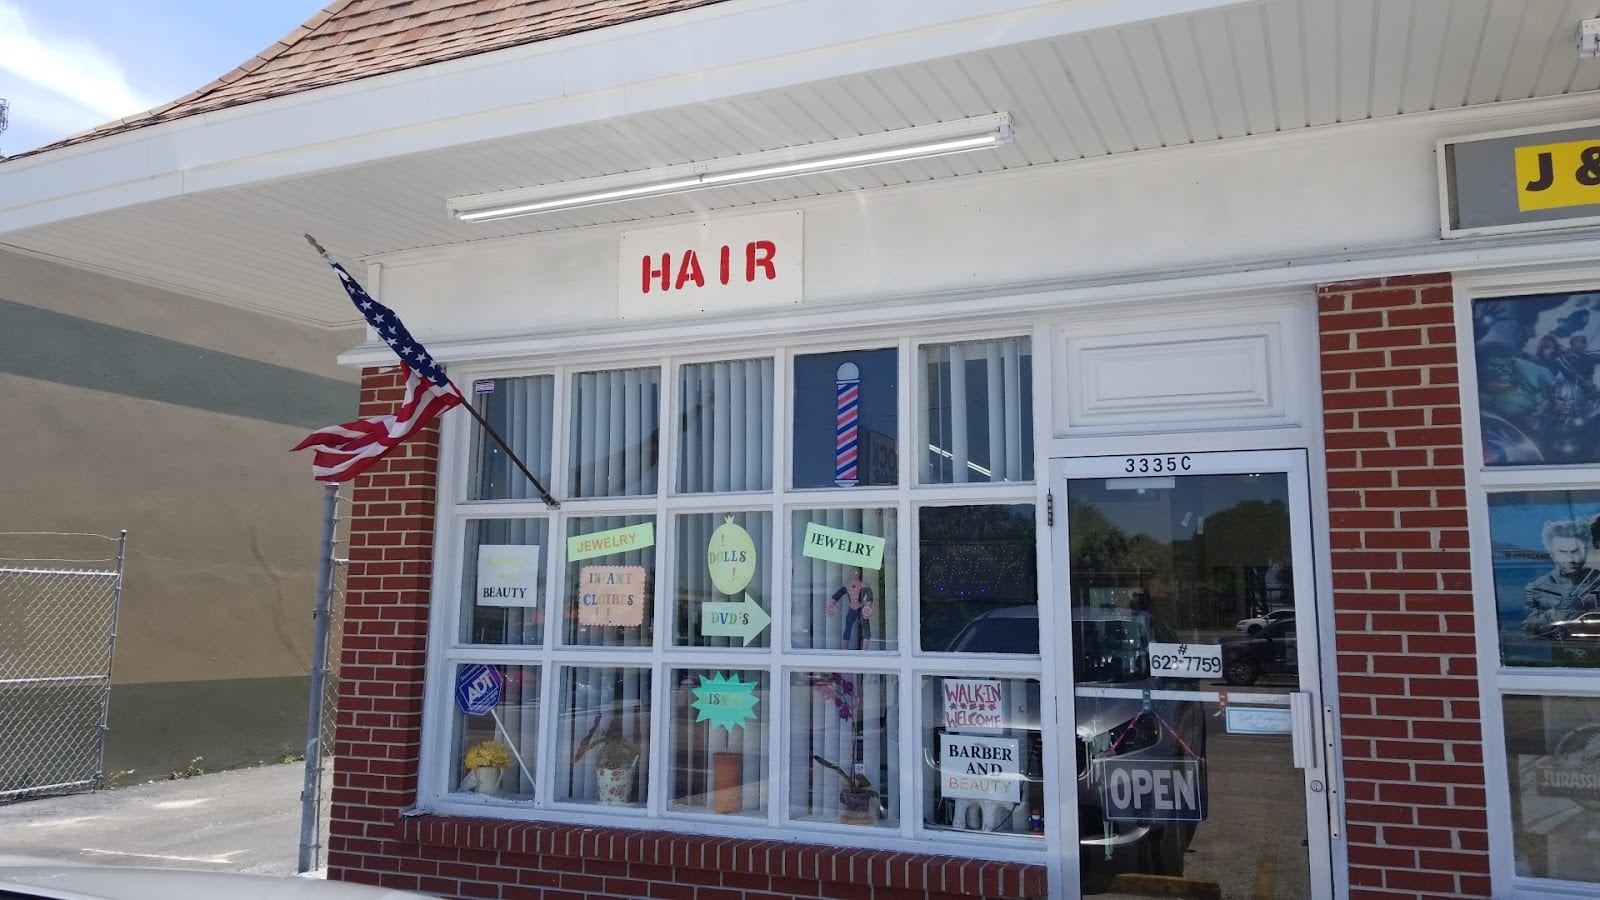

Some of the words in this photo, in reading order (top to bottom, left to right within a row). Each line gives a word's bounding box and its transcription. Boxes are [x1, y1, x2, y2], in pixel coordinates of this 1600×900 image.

[1525, 152, 1554, 192] J
[642, 240, 776, 294] HAIR
[1125, 455, 1192, 473] 3335C
[577, 532, 637, 553] JEWELRY
[810, 532, 875, 557] JEWELRY
[709, 551, 747, 564] DOLLS
[589, 572, 633, 585] INANT
[483, 586, 527, 599] BEAUTY
[468, 670, 493, 705] ADT
[949, 744, 1013, 762] BARBER
[966, 762, 1003, 777] AND
[949, 777, 1012, 793] BEAUTY
[1110, 768, 1196, 811] OPEN
